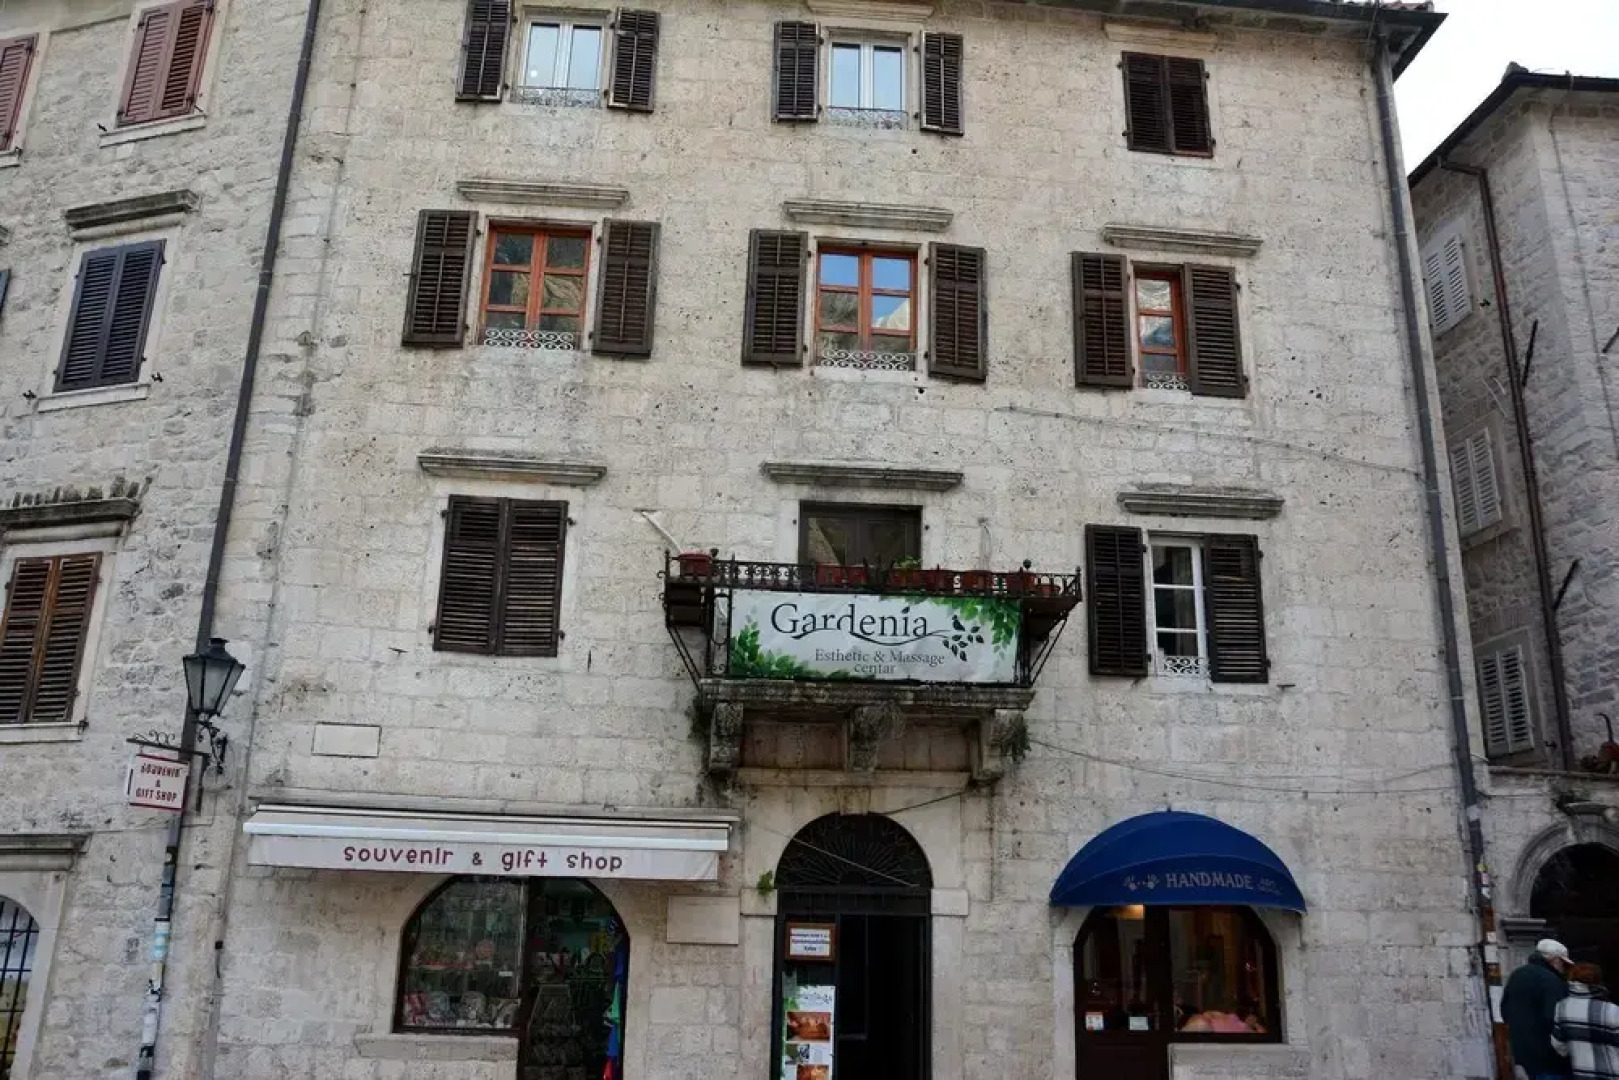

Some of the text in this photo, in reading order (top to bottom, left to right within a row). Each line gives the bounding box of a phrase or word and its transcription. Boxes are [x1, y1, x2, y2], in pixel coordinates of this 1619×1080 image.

[770, 602, 930, 644] Gardenia
[815, 648, 945, 667] Esthetic & Massage
[853, 662, 896, 674] centar
[155, 779, 161, 788] &
[135, 788, 178, 803] GIFT SHOP
[342, 846, 623, 872] souvenir & gift shop
[1165, 872, 1254, 890] HANDMADE
